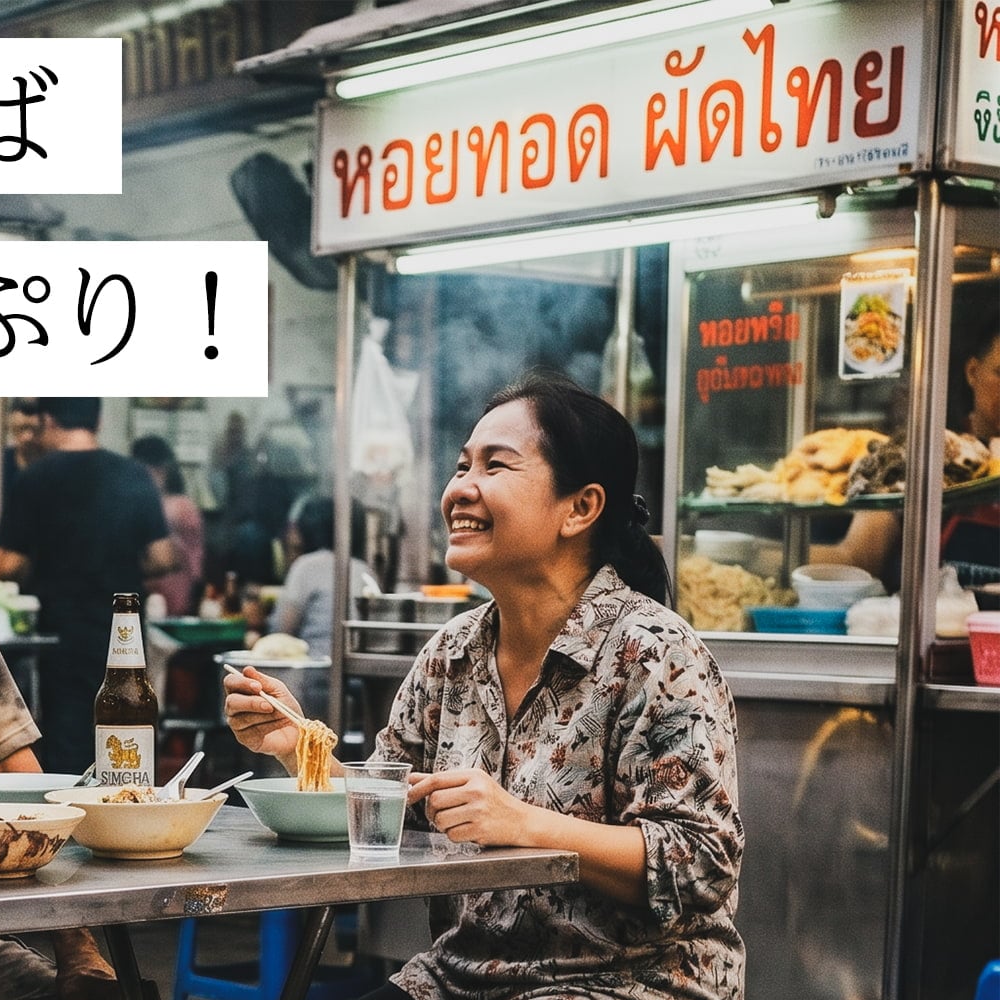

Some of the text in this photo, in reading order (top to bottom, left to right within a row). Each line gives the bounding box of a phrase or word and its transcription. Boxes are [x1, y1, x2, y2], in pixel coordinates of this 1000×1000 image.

[333, 23, 905, 219] หอยทอด ผัดไทย
